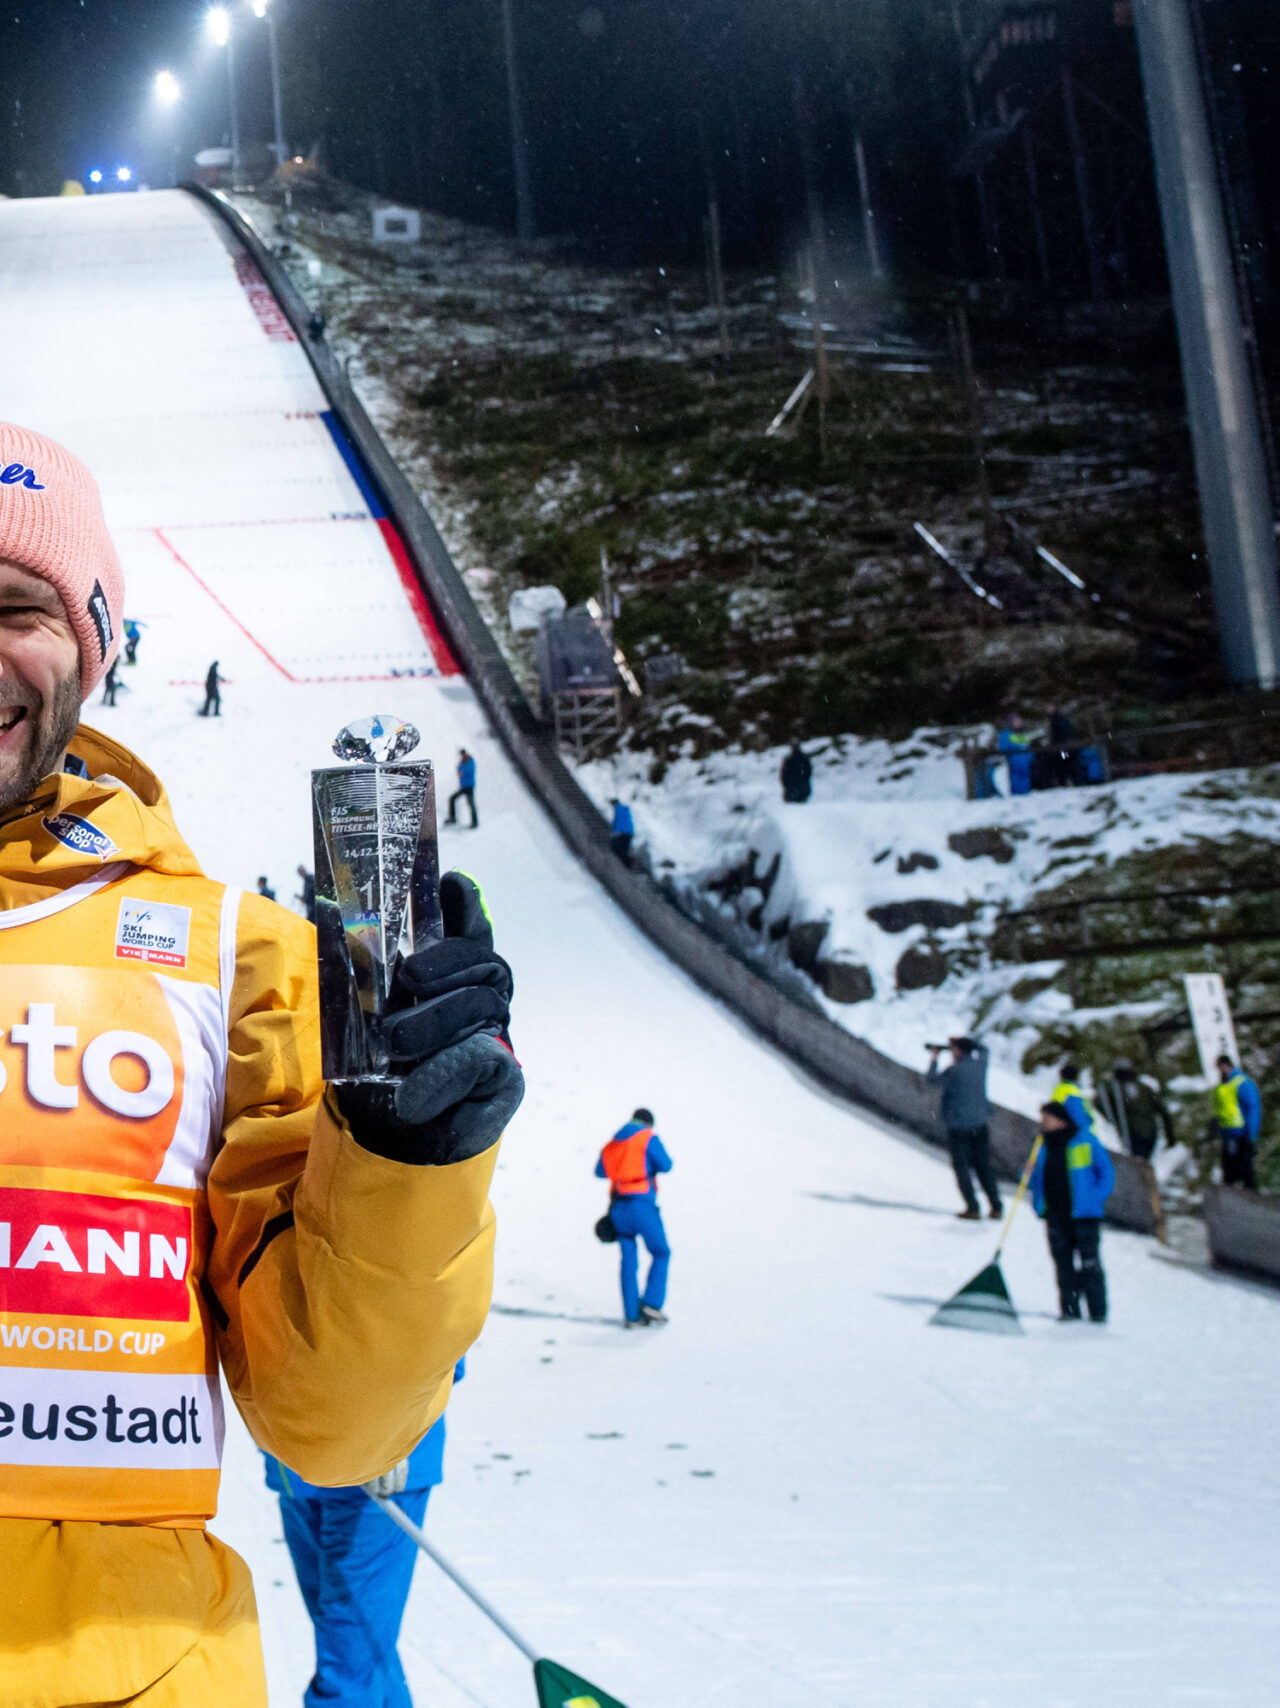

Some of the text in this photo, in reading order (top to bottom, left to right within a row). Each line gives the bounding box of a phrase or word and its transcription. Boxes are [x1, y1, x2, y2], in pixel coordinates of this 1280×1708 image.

[48, 815, 108, 847] personal
[59, 827, 91, 849] shop
[125, 911, 152, 921] FIS
[123, 924, 142, 932] SKI
[122, 931, 176, 944] JUMPING
[122, 938, 154, 947] WORLD
[0, 1325, 113, 1353] WORLD
[119, 1331, 165, 1355] CUP
